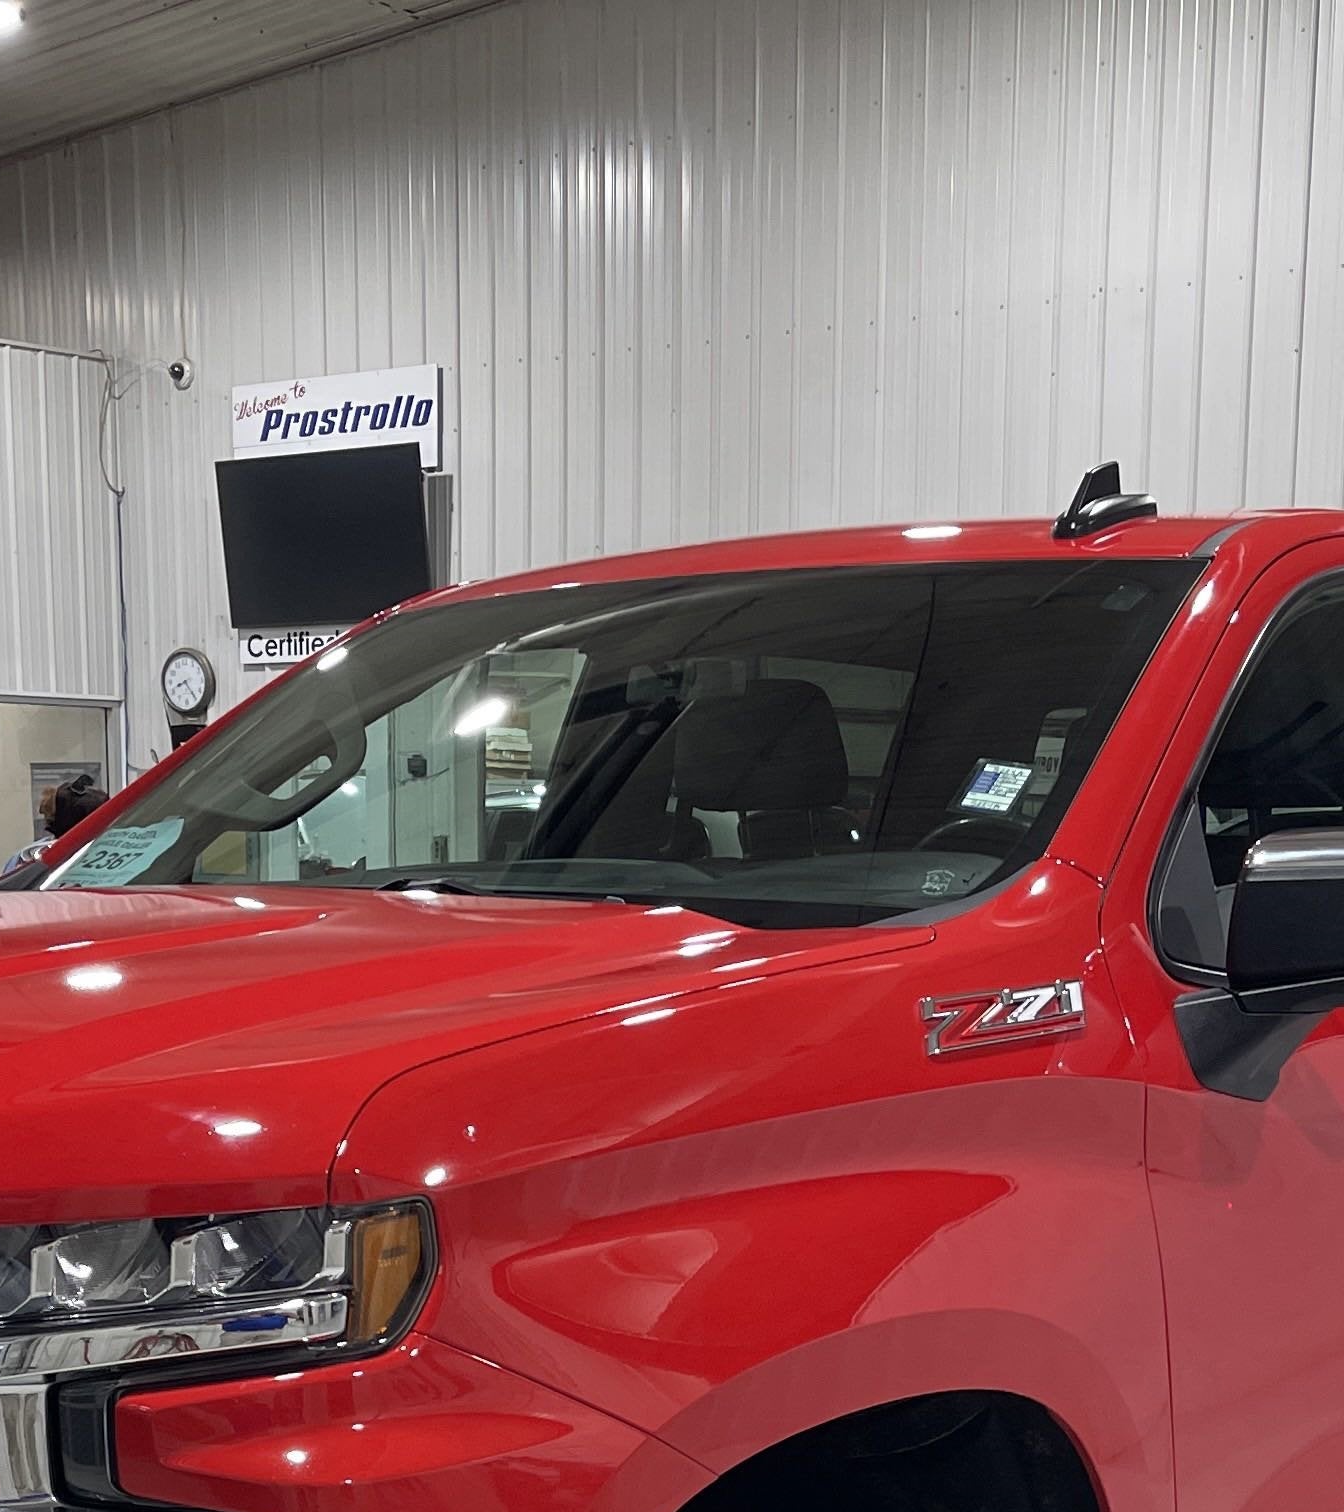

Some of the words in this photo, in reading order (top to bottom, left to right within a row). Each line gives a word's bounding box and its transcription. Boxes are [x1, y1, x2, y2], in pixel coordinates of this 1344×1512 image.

[234, 394, 288, 421] Welcome
[289, 381, 306, 399] to
[259, 394, 434, 442] Prostrollo
[919, 978, 1086, 1056] Z71
